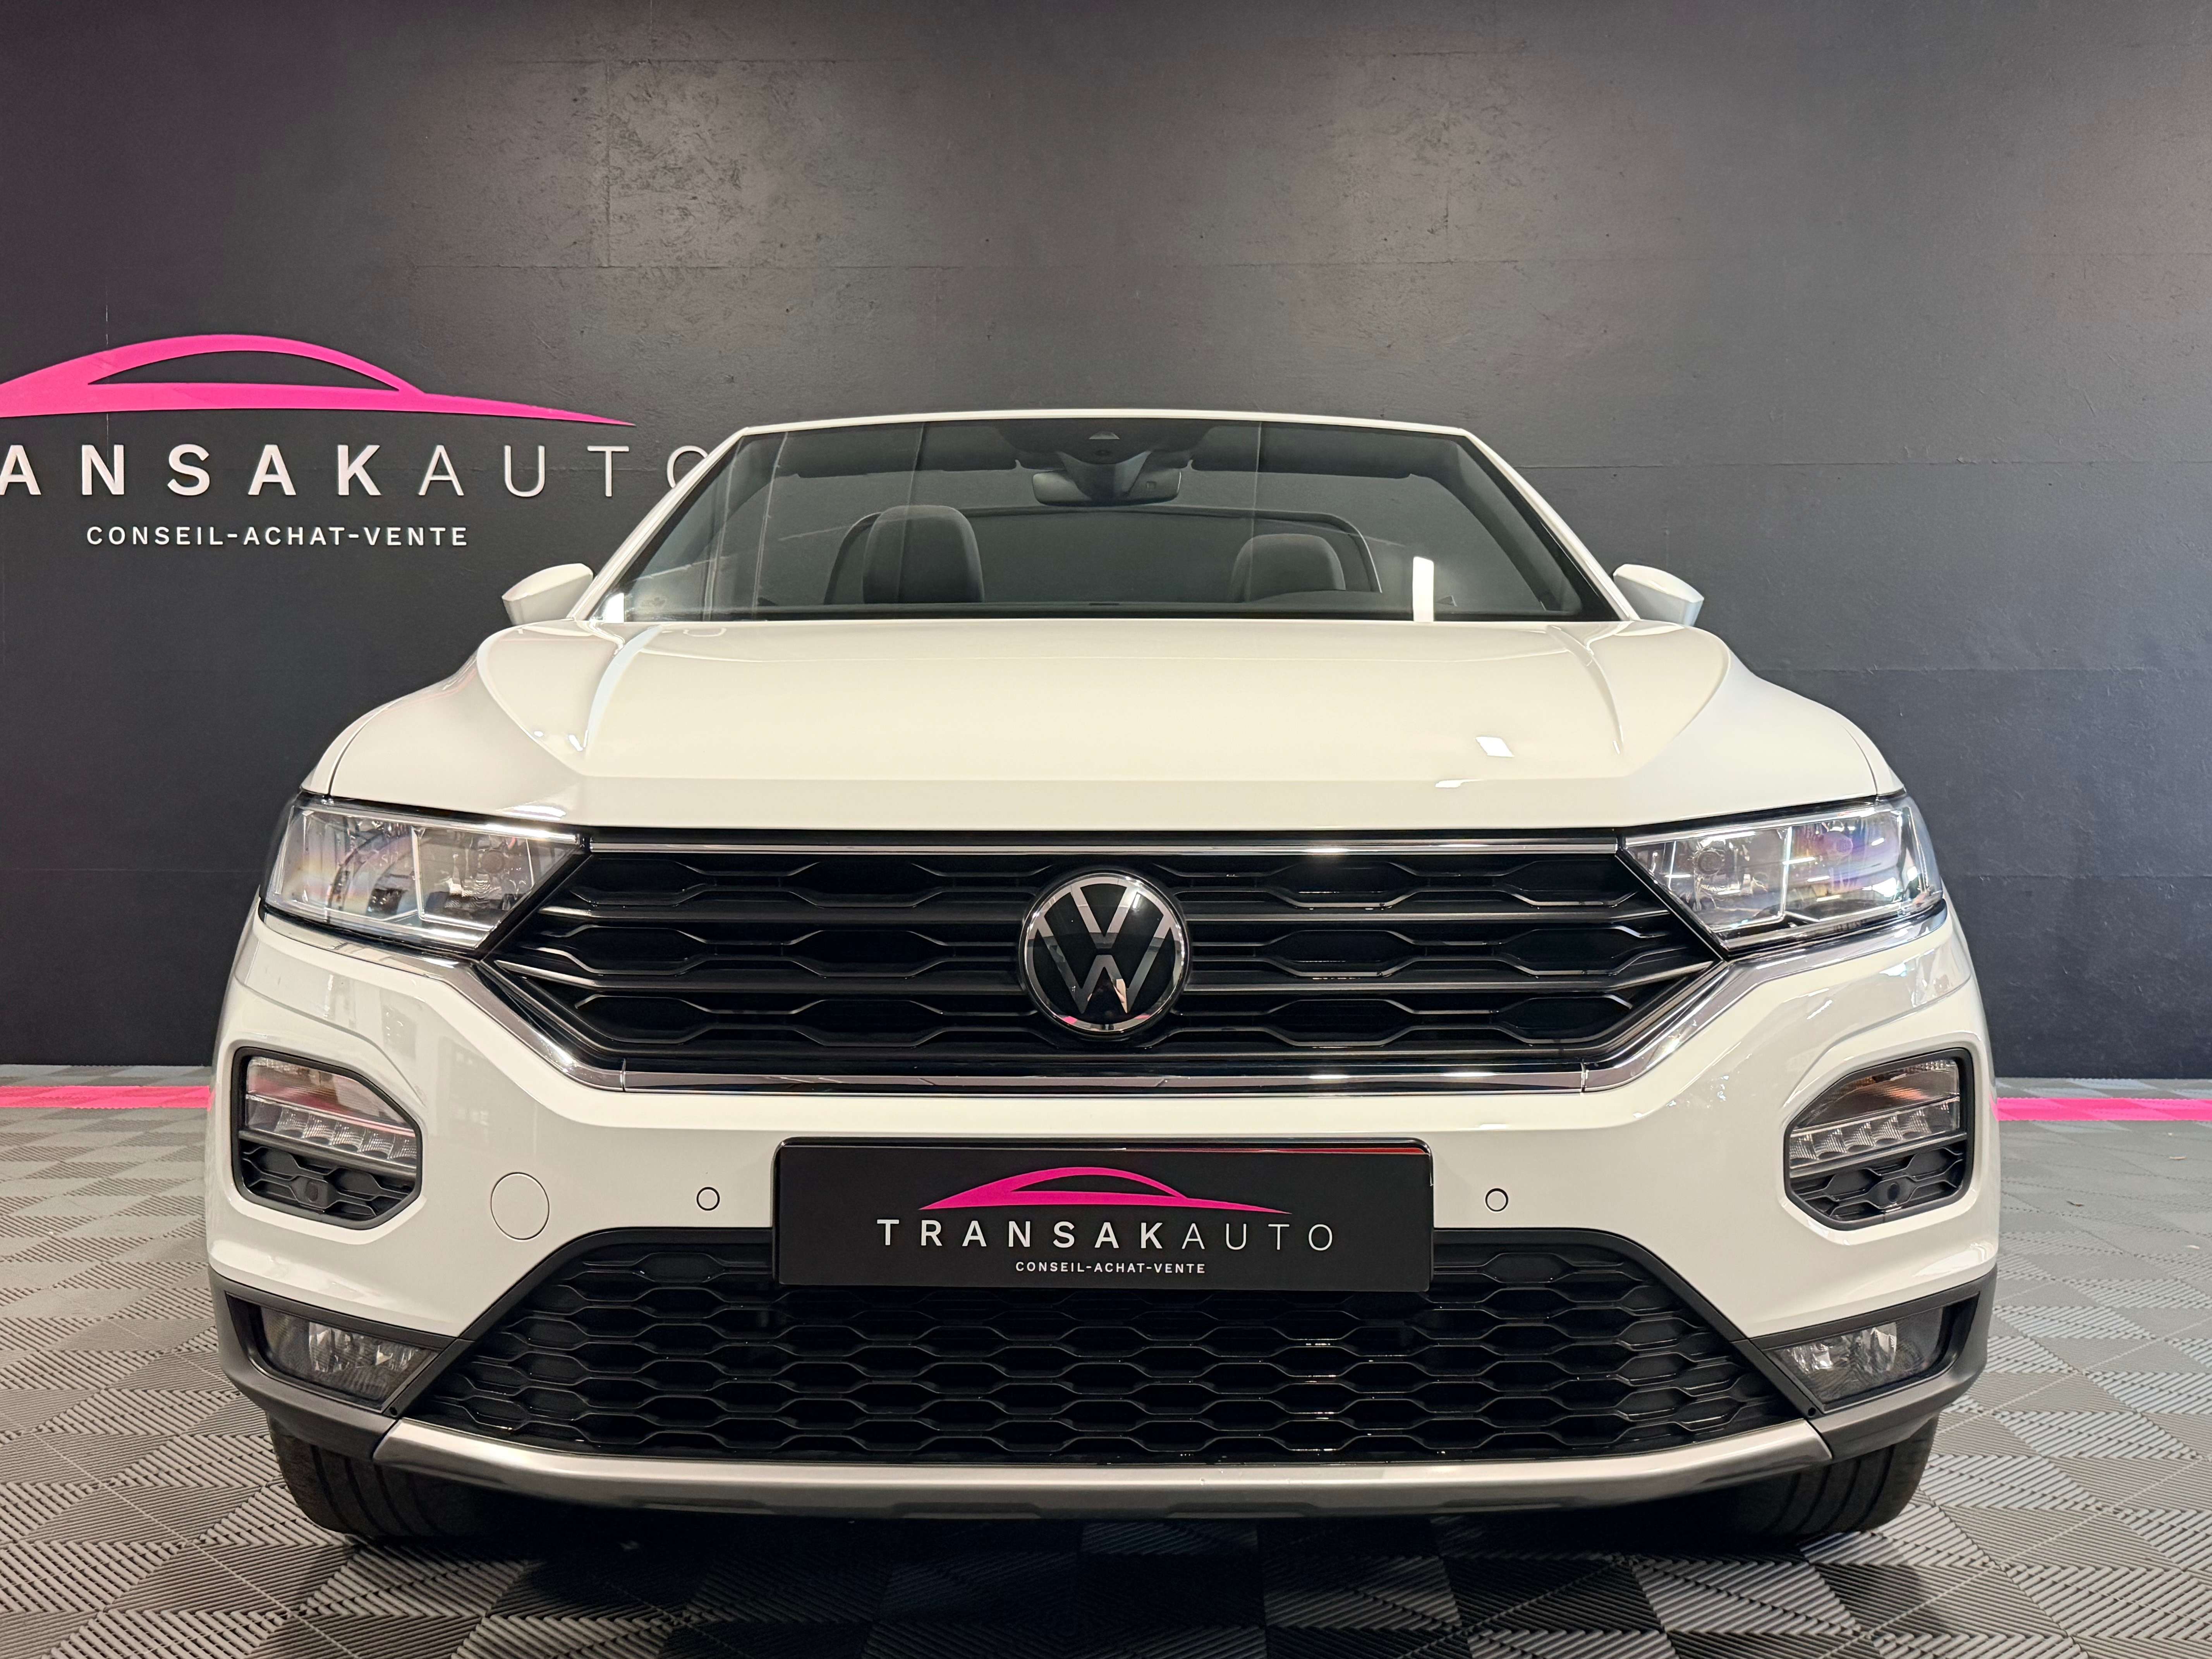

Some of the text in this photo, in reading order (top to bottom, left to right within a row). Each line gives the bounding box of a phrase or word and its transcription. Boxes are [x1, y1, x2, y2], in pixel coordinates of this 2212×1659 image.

[86, 526, 467, 546] CONSEIL-ACHAT-VENTE
[876, 1218, 1333, 1252] TRANSAKAUTO
[1015, 1261, 1206, 1274] CONSEIL-ACHAT-VENTE
